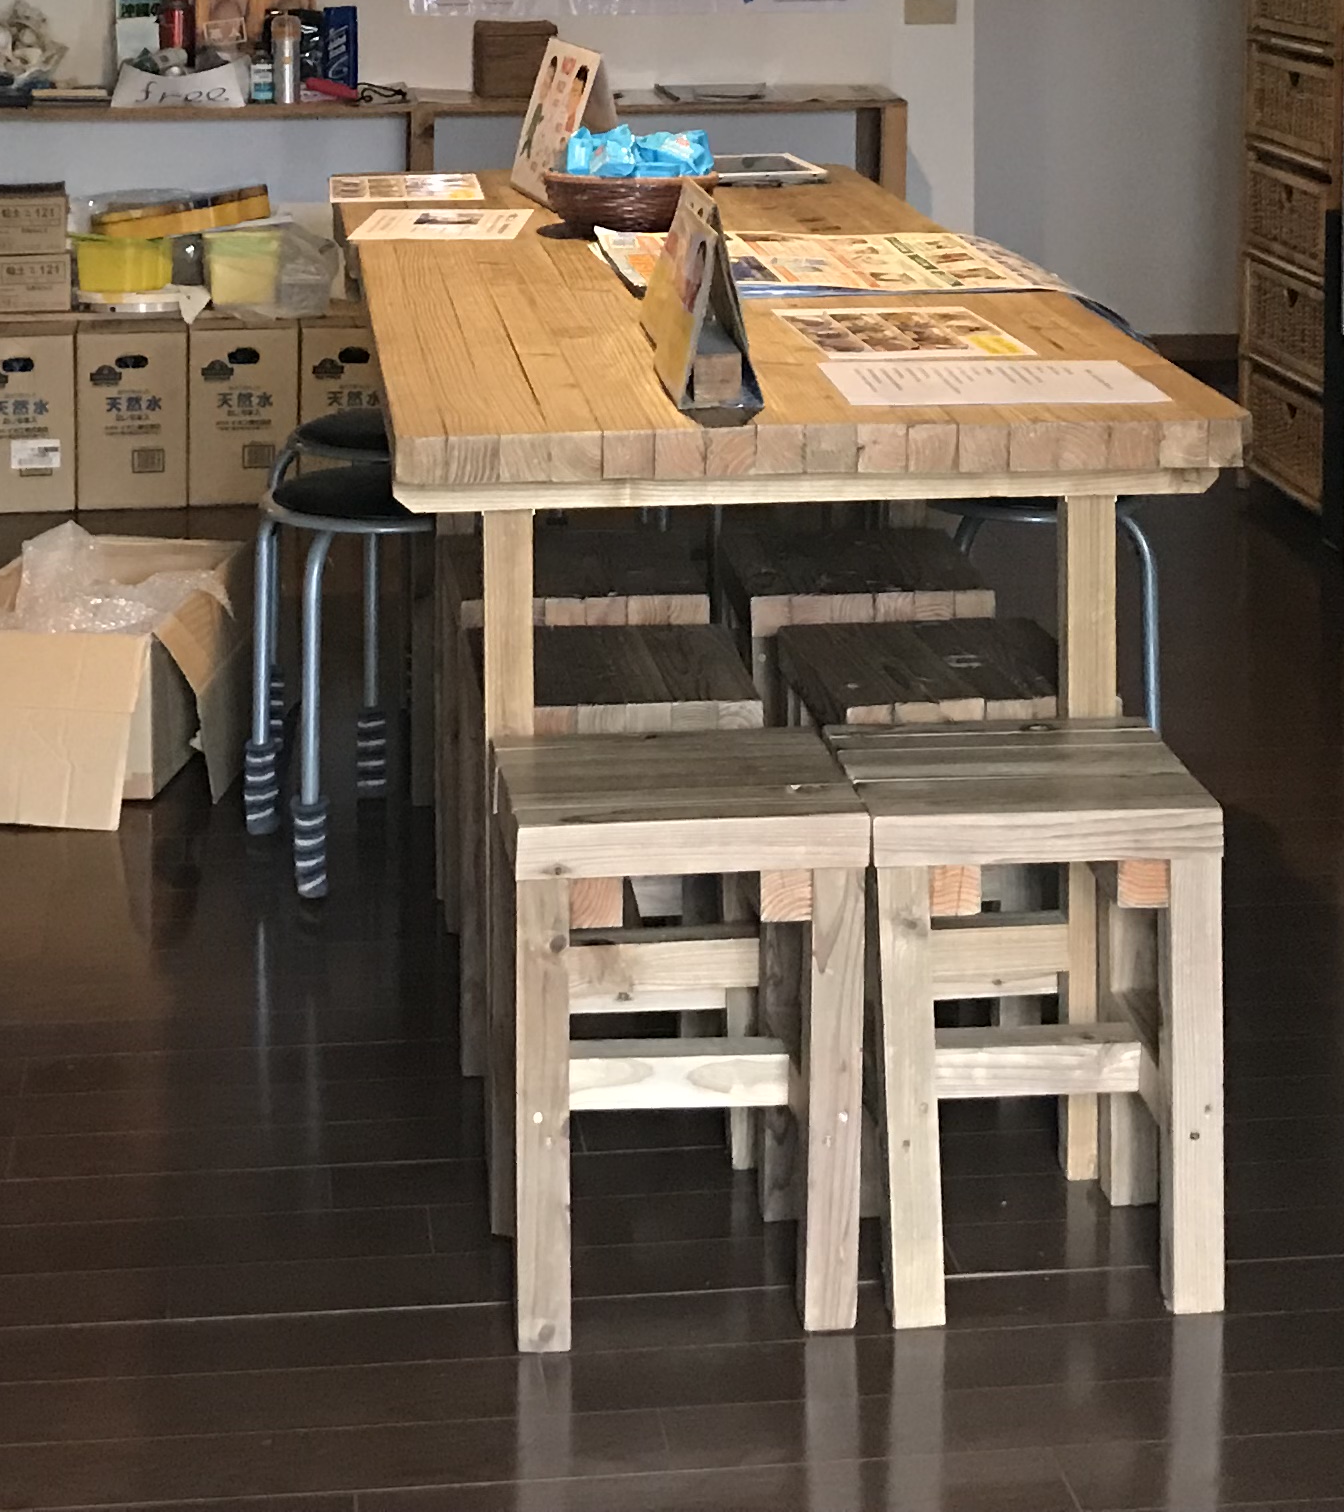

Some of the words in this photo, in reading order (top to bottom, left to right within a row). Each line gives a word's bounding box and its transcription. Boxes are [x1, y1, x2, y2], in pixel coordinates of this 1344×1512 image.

[134, 81, 230, 104] free
[105, 395, 163, 413] 天然水
[217, 392, 273, 409] 天然水
